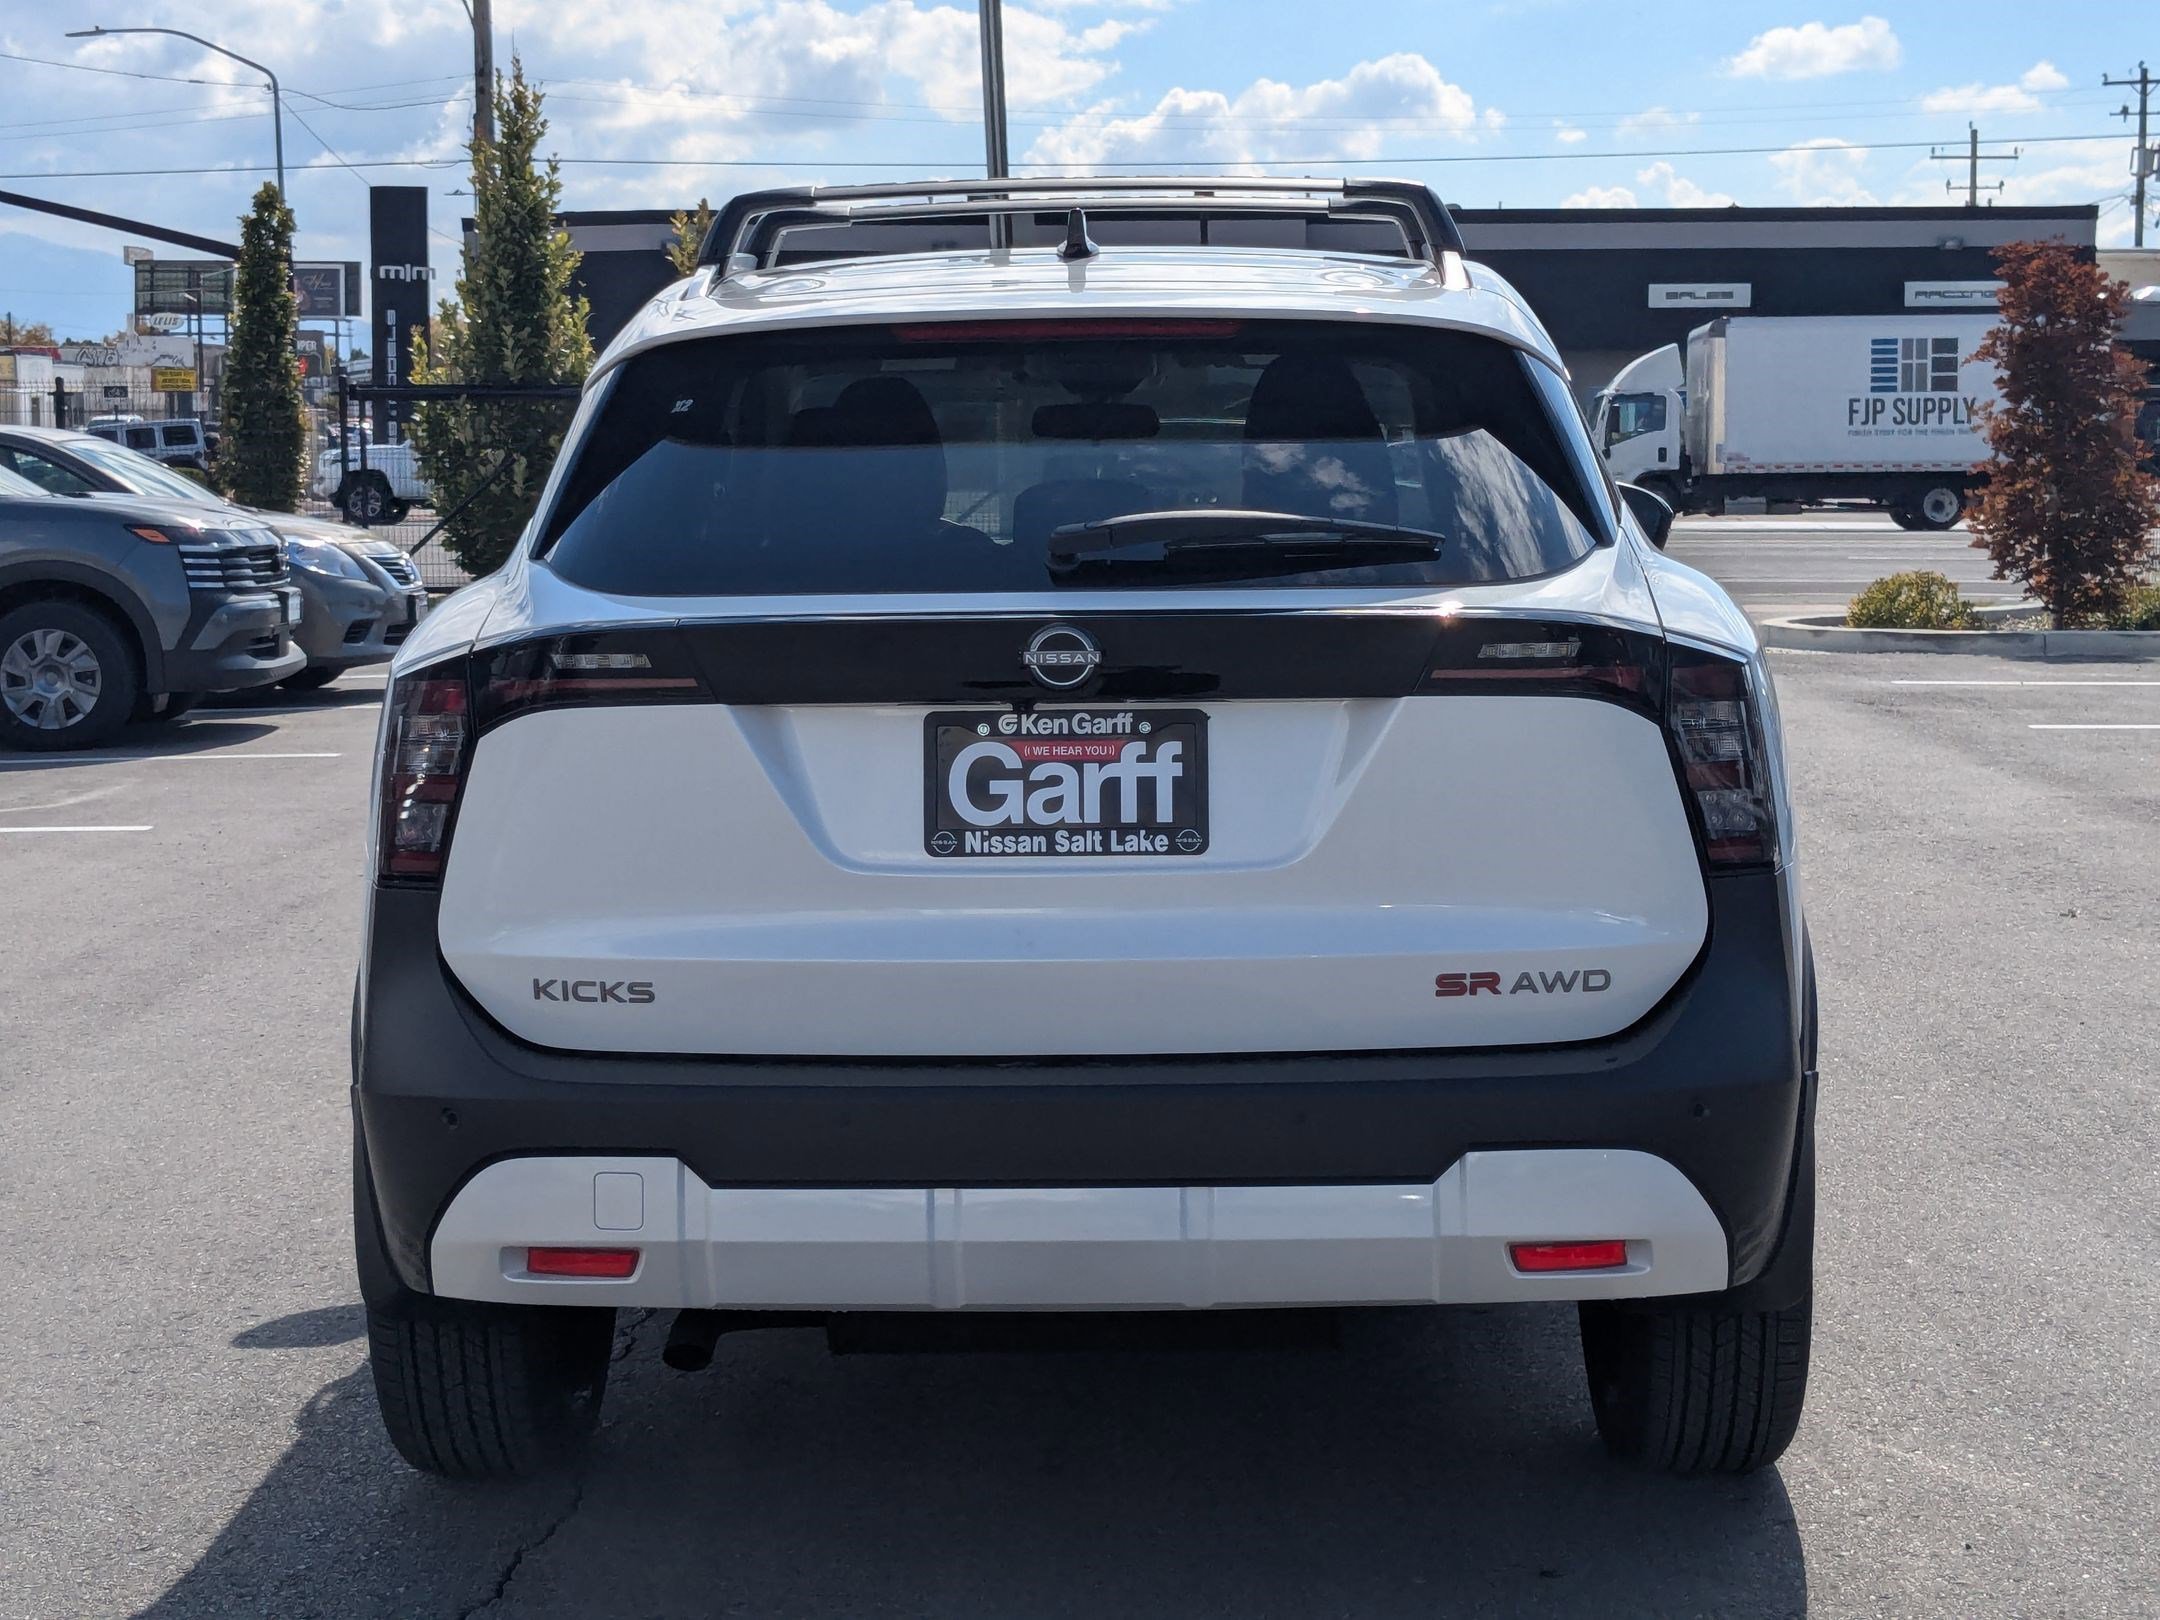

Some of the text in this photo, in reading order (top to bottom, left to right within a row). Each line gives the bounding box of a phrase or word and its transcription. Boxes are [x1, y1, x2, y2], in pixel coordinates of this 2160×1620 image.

[1848, 396, 1977, 426] FJP SUPPLY
[1025, 653, 1100, 664] NISSAN
[1020, 713, 1069, 735] Ken
[1072, 712, 1133, 735] Garff
[1032, 745, 1107, 756] WE HEAR YOU
[949, 741, 1183, 827] Garff
[965, 829, 1169, 853] Nissan Salt Lake
[533, 978, 656, 1004] KICKS
[1435, 969, 1611, 997] SR AWD
